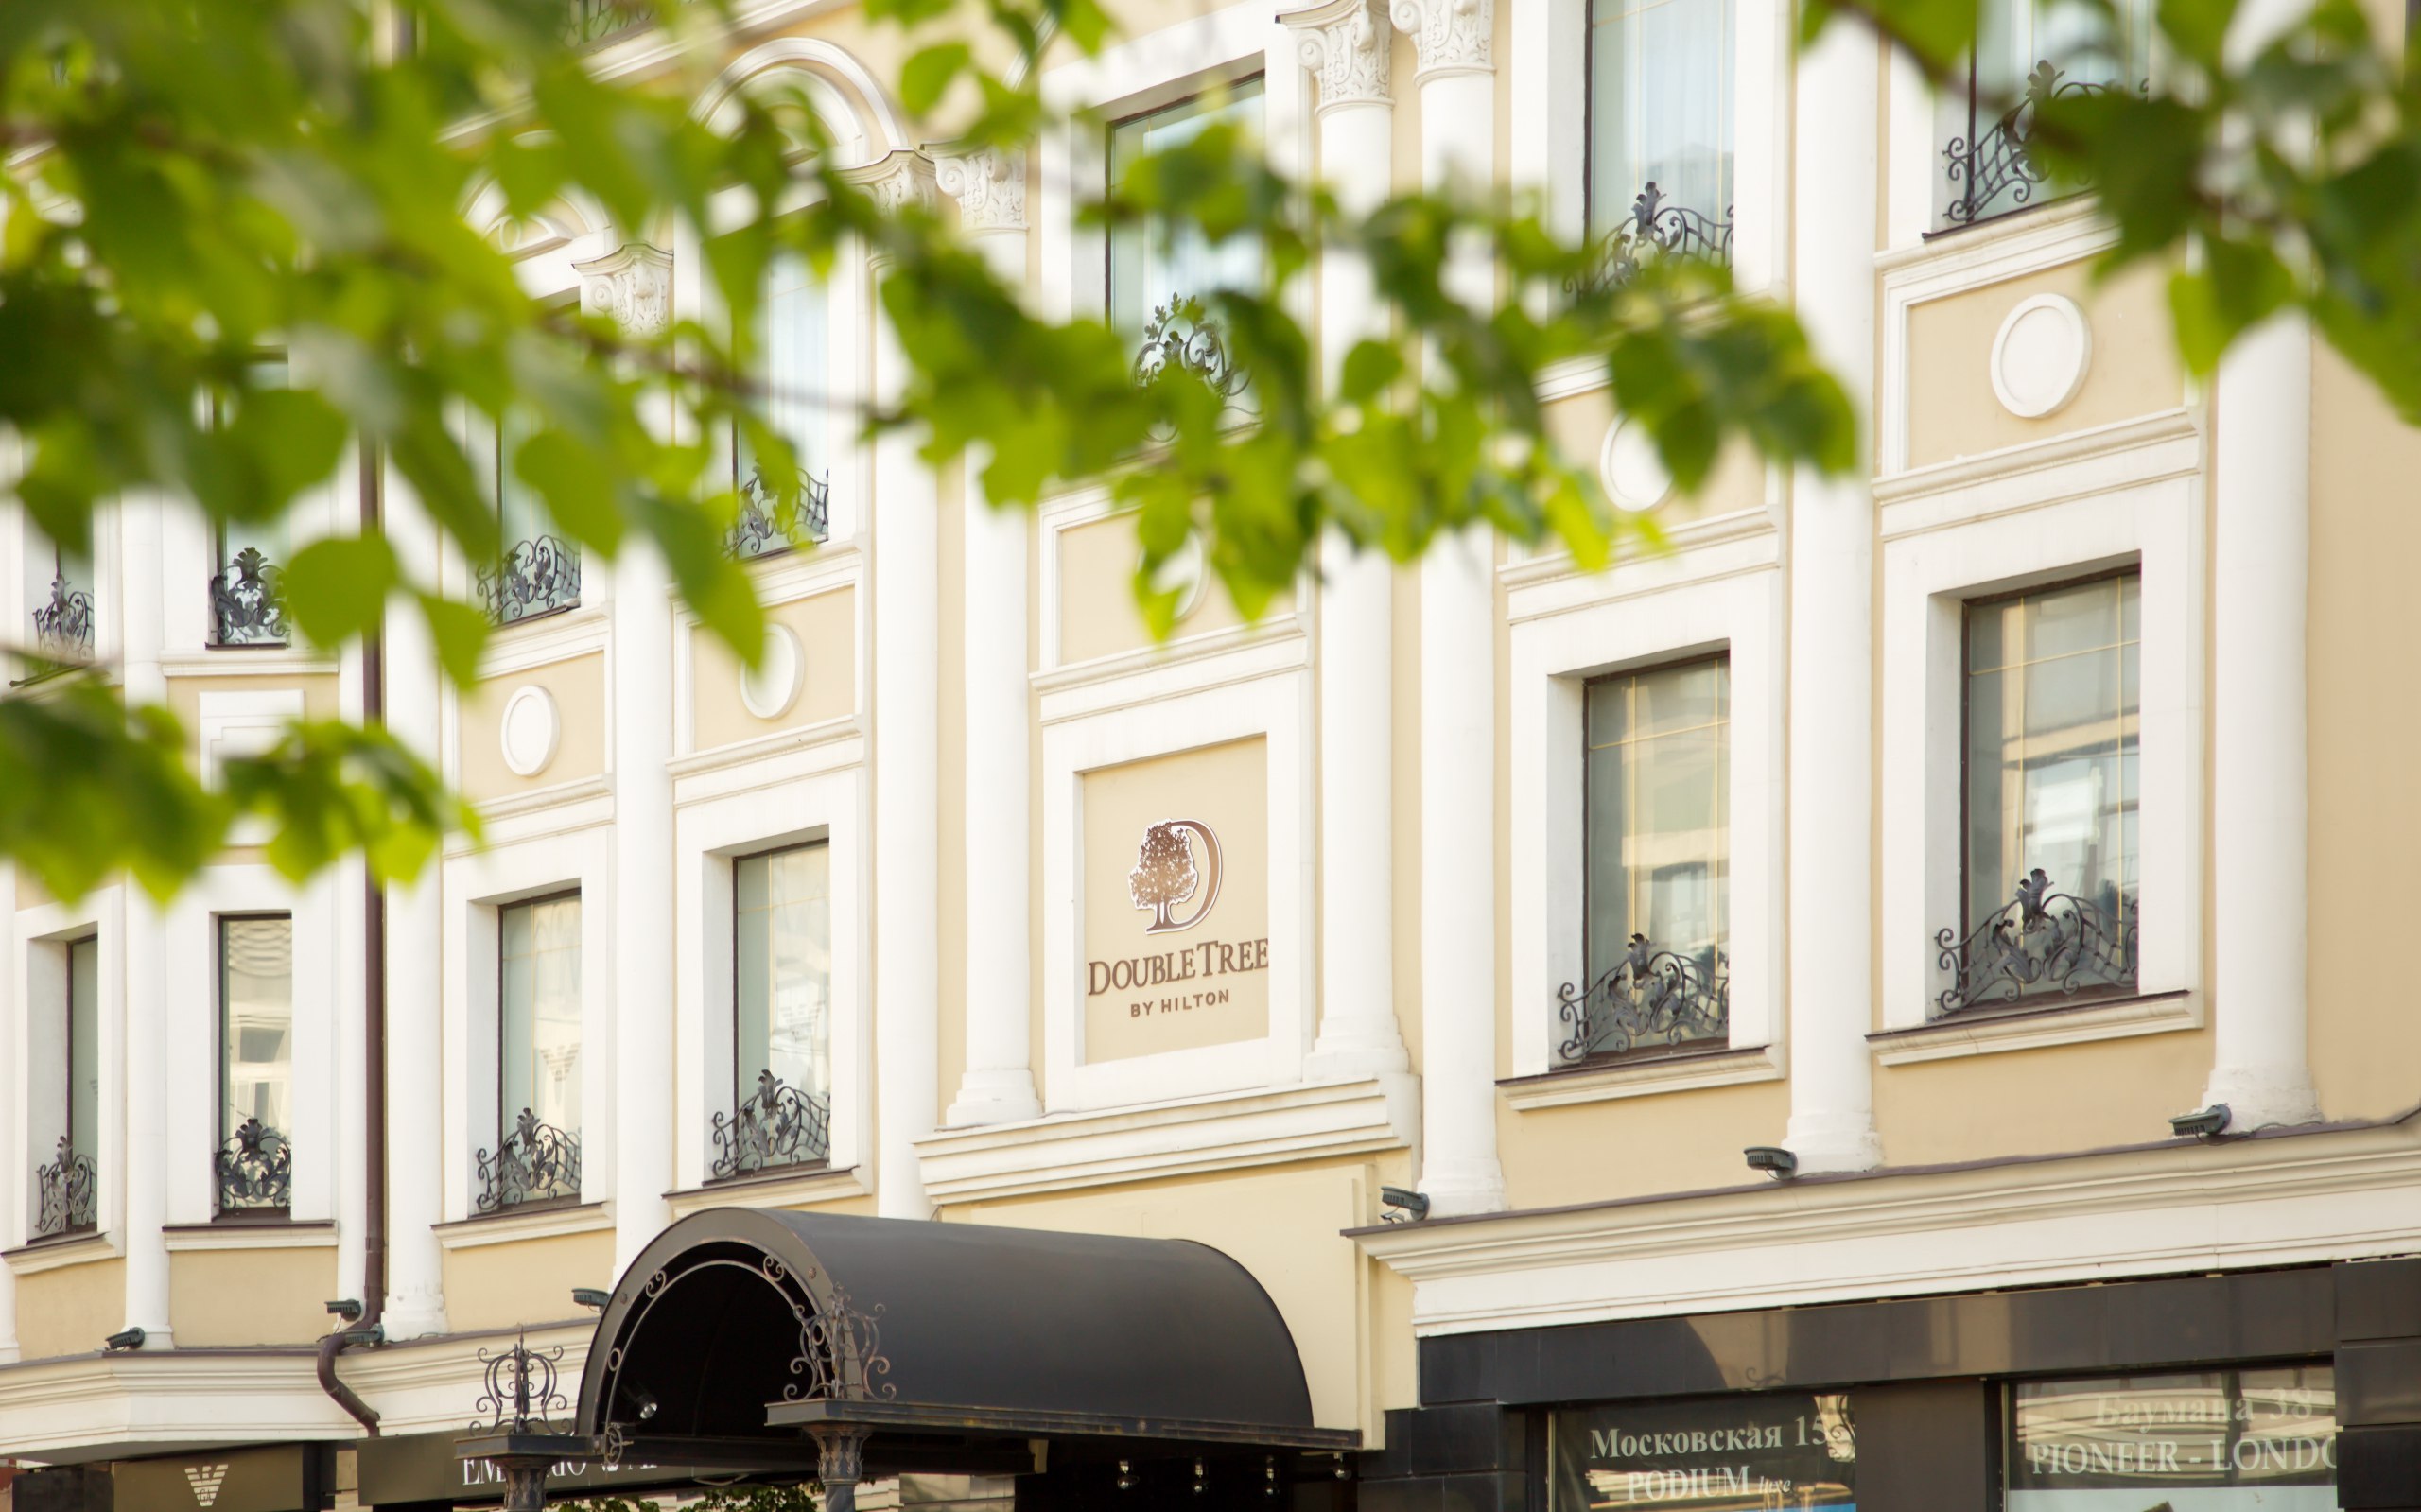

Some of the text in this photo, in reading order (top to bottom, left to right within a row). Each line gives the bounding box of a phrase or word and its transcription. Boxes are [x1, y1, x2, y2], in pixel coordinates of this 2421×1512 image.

[1088, 937, 1269, 996] DOUBLETREE
[1130, 989, 1229, 1017] BY HILTON
[2094, 1386, 2313, 1434] Баумана 38
[1590, 1424, 1783, 1459] Московская
[2031, 1439, 2181, 1475] PIONEER
[1626, 1465, 1792, 1502] PODIUM luxe
